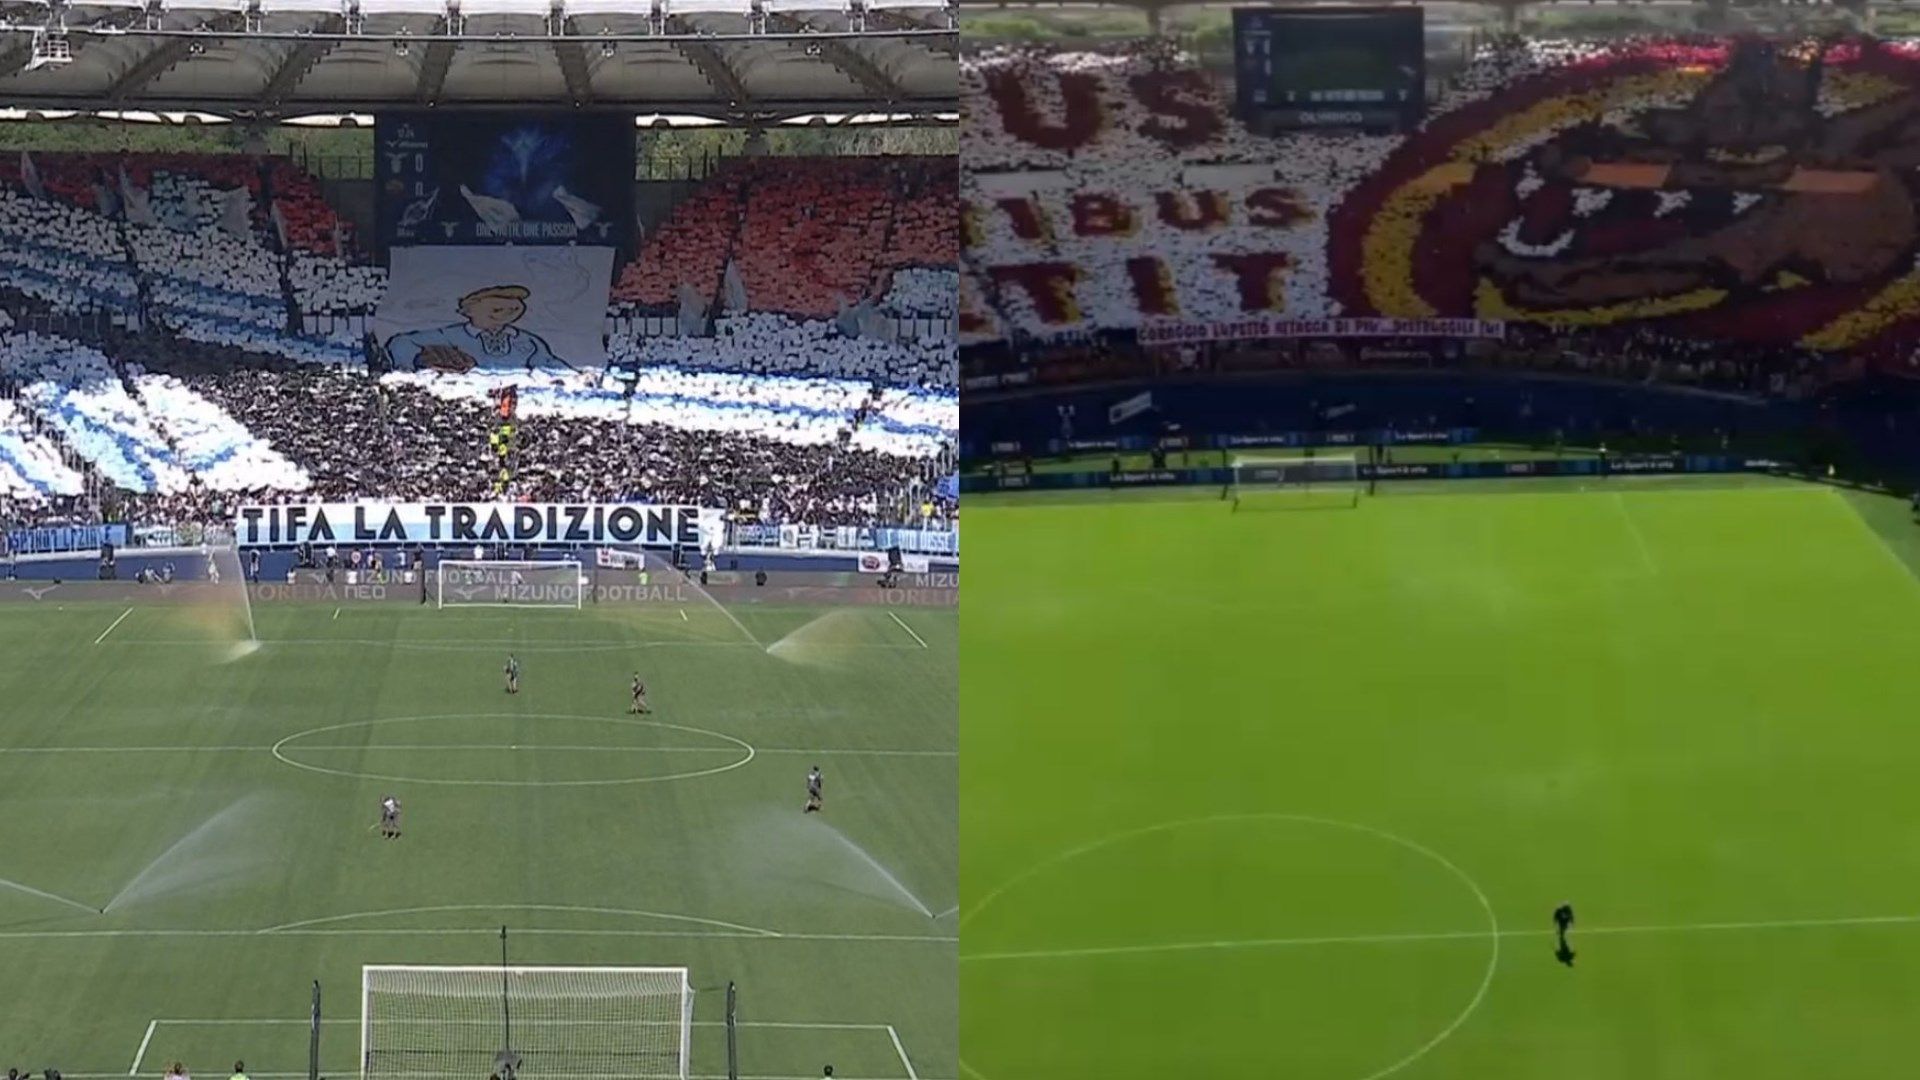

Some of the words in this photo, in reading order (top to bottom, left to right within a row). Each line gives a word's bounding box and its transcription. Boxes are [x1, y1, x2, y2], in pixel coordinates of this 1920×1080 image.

[242, 506, 340, 542] TIFA
[359, 505, 412, 540] LA
[430, 505, 699, 542] TRADIZIONE
[495, 585, 574, 601] MIZUNO
[584, 585, 688, 601] FOOTBALL
